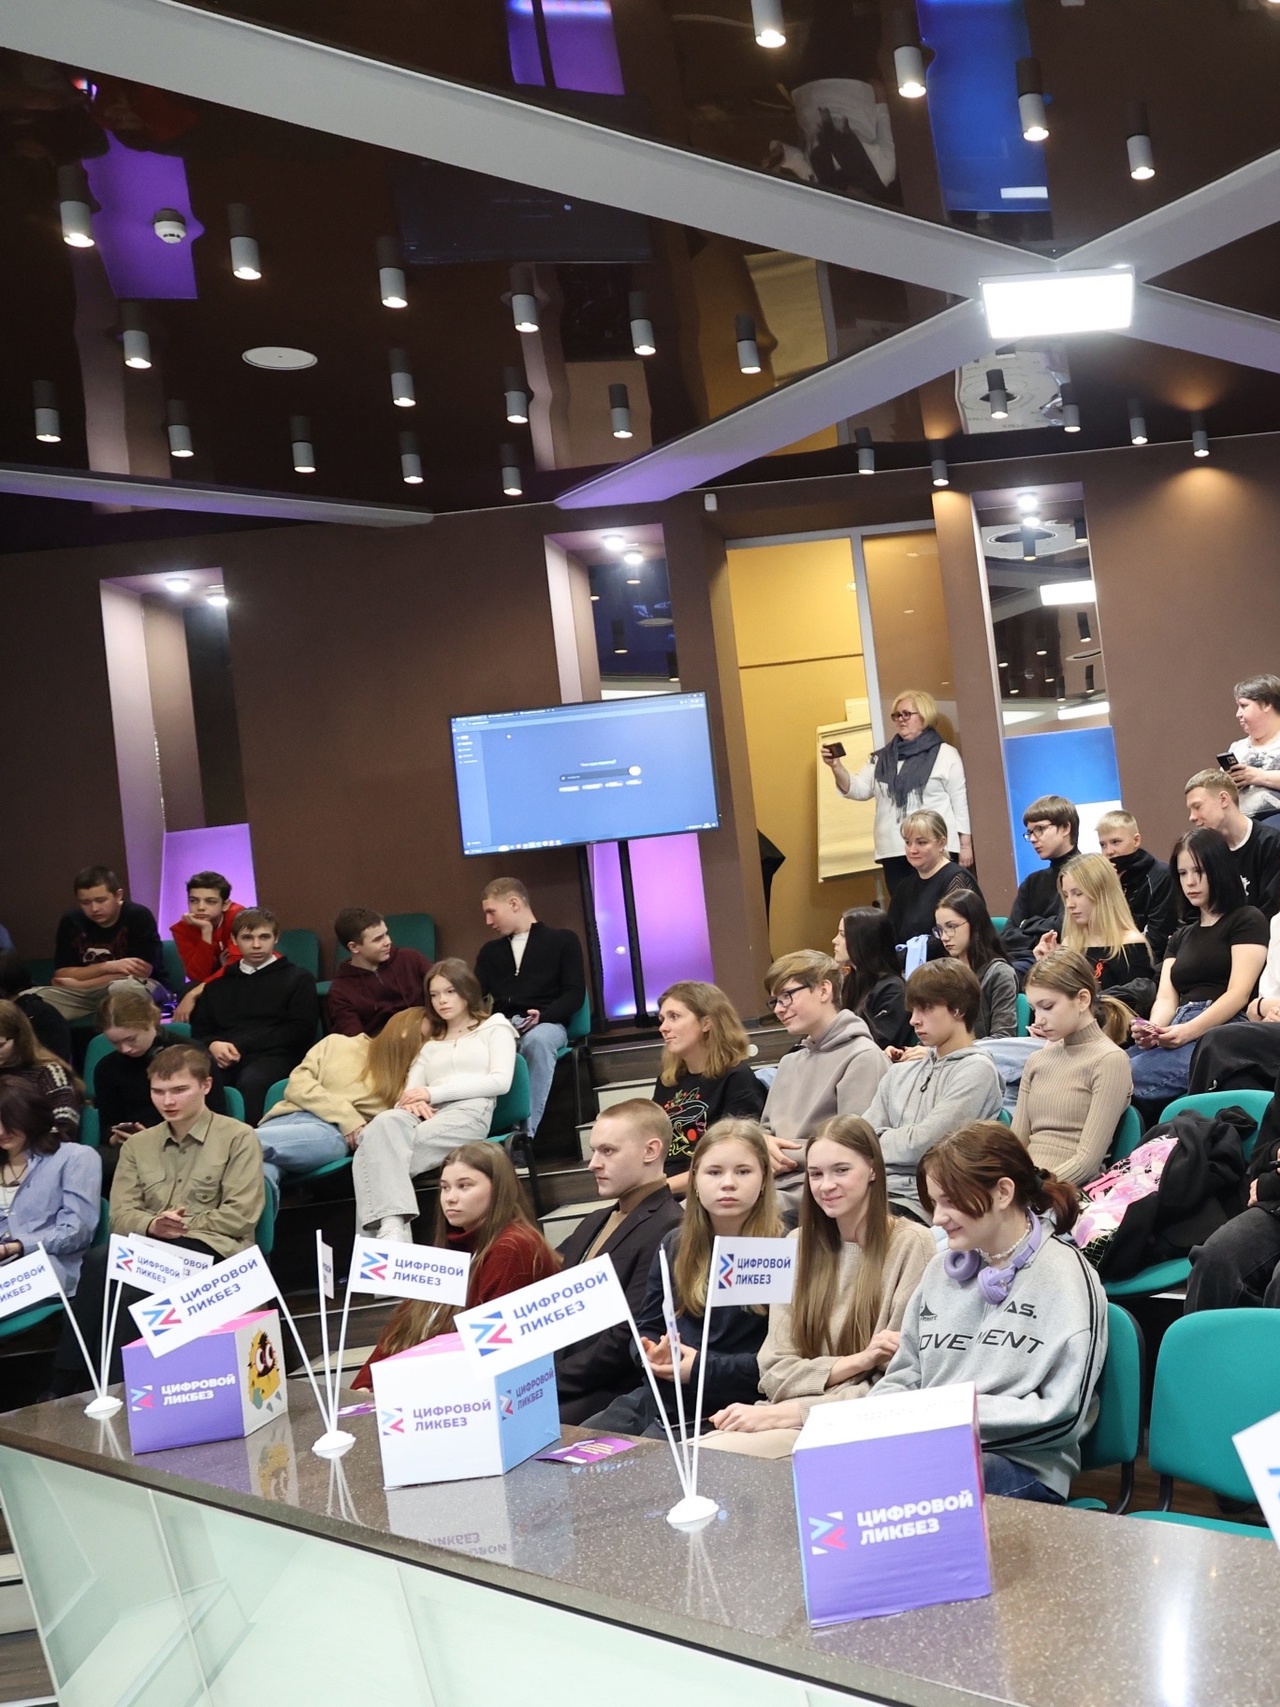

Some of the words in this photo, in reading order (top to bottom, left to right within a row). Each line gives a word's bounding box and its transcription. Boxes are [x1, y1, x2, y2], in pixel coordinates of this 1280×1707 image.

[137, 1256, 180, 1279] ЦИФРОВОЙ
[395, 1258, 464, 1277] ЦИФРОВОЙ
[737, 1257, 791, 1270] ЦИФРОВОЙ
[0, 1264, 45, 1290] ФРОВОЙ
[135, 1267, 167, 1284] ЛИКБЕЗ
[180, 1258, 259, 1304] ЦИФРОВОЙ
[392, 1271, 441, 1286] ЛИКБЕЗ
[735, 1274, 771, 1285] ЛИКБЕЗ
[0, 1283, 31, 1302] ИКБЕЗ
[187, 1283, 241, 1316] ЛИКБЕЗ
[513, 1271, 608, 1320] ЦИФРОВОЙ
[519, 1300, 586, 1336] ЛИКБЕЗ
[161, 1374, 236, 1395] ЦИФРОВОЙ
[516, 1367, 554, 1397] ЦИФРОВОЙ
[163, 1389, 214, 1406] ЛИКБЕЗ
[517, 1388, 543, 1410] ЛИКБЕЗ
[413, 1399, 491, 1419] ЦИФРОВОЙ
[415, 1417, 468, 1431] ЛИКБЕЗ
[856, 1489, 974, 1528] ЦИФРОВОЙ
[860, 1517, 940, 1545] ЛИКБЕЗ
